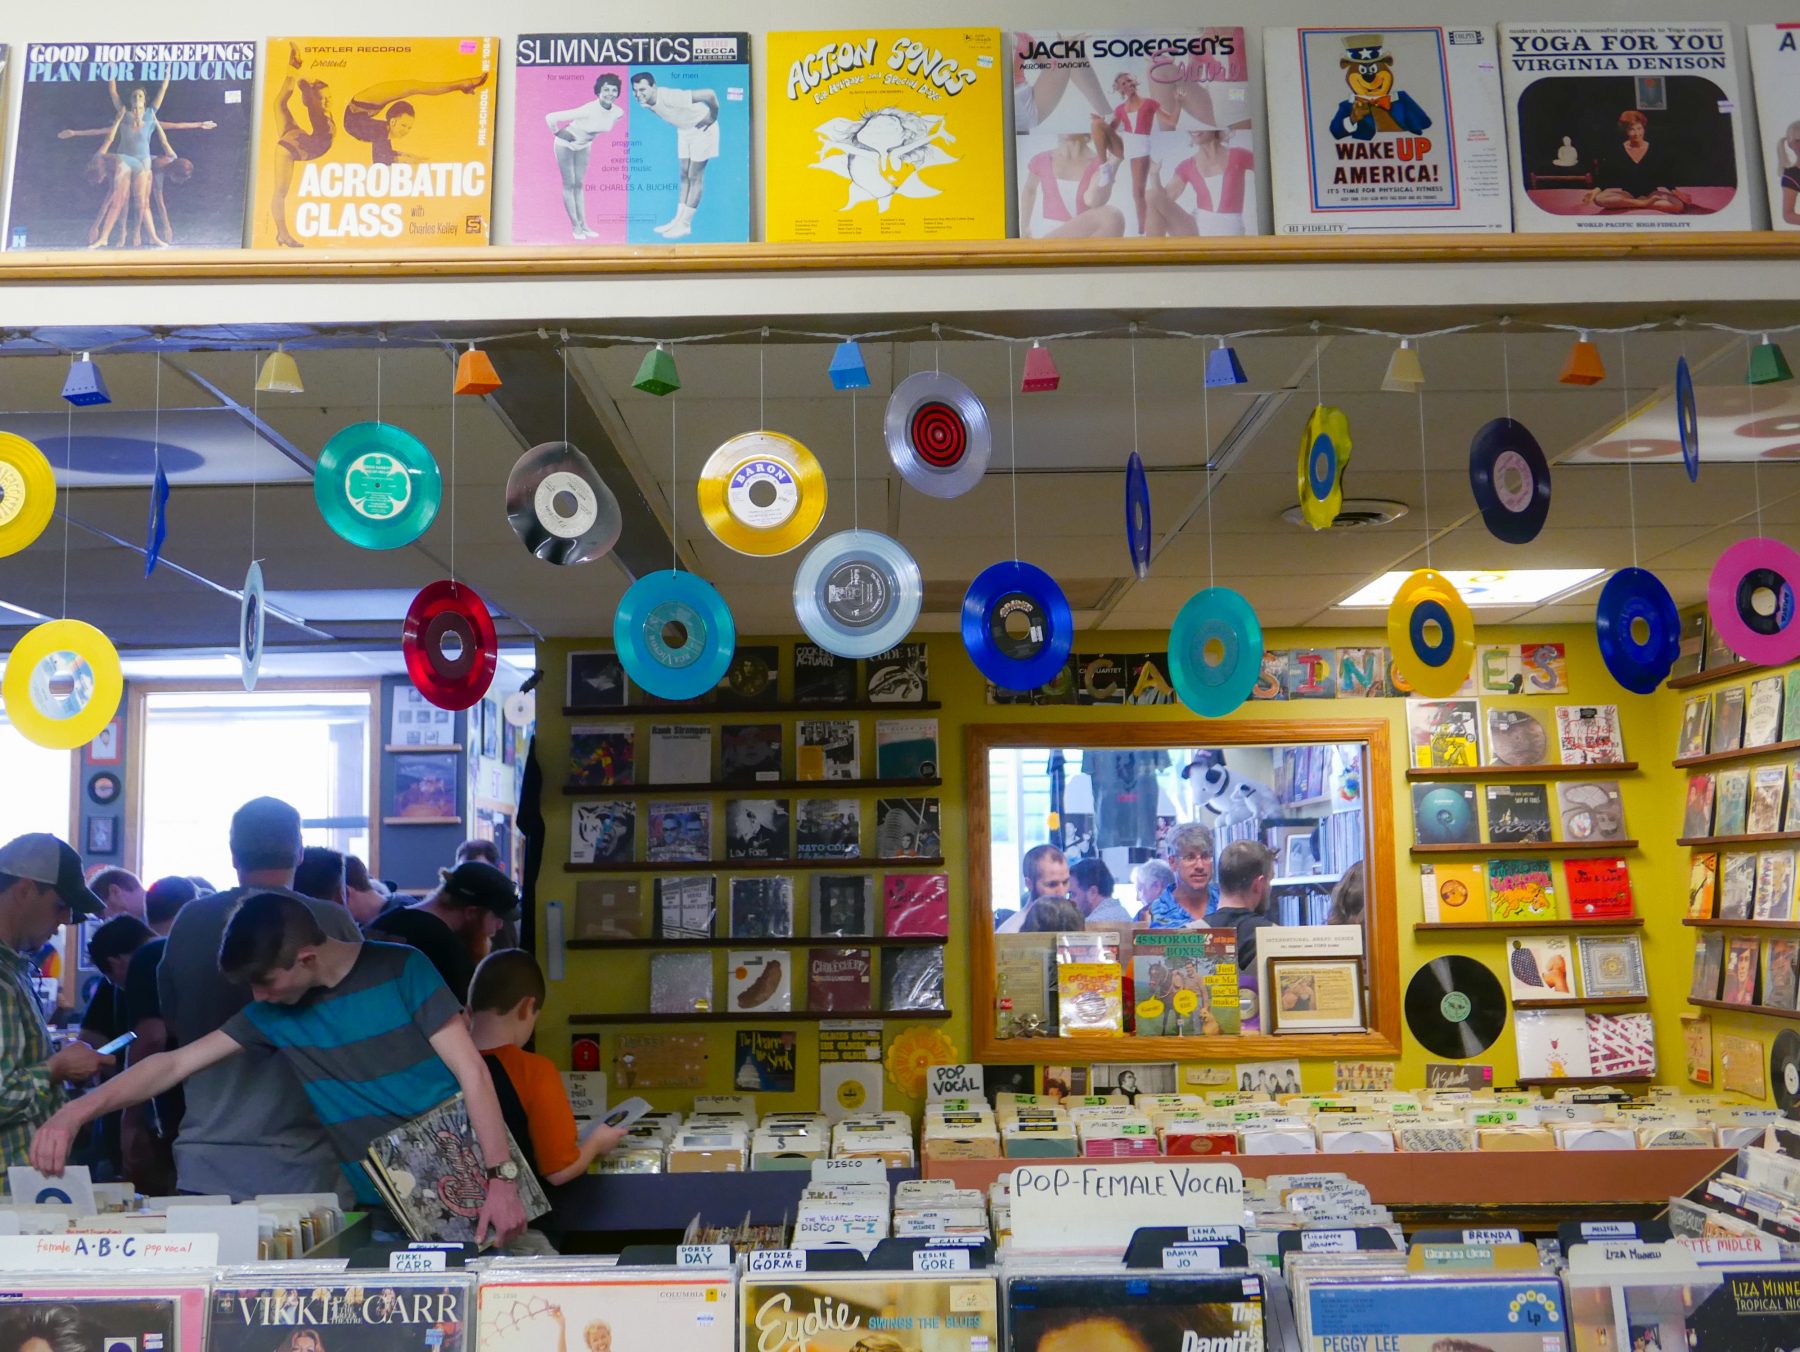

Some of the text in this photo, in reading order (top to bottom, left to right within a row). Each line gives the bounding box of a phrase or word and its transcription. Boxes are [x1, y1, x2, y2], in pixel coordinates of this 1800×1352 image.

[1019, 37, 1234, 60] JACKI SORENSEN'S
[1510, 35, 1724, 51] YOGA FOR YOU
[30, 43, 254, 63] GOOD HOUSEKEEPING'S
[518, 38, 691, 64] SLIMNASTICS
[1512, 57, 1726, 71] VIRGINIA DENISON
[28, 61, 253, 82] PLAN FOR REDUCING
[478, 89, 489, 146] PRE-SCHOOL
[612, 140, 642, 148] program
[1334, 137, 1432, 161] WAKE UP
[298, 162, 485, 197] ACROBATIC
[1333, 165, 1438, 185] AMERICA!
[600, 184, 634, 192] CHARLES
[411, 205, 425, 217] with
[296, 202, 403, 237] CLASS
[409, 223, 435, 234] Charles
[1302, 224, 1344, 232] FIDELITY
[735, 463, 786, 484] BARON
[1151, 934, 1203, 944] STORAGE
[1166, 947, 1203, 957] BOXES
[1217, 965, 1234, 973] Just
[937, 1065, 965, 1080] POP
[933, 1078, 980, 1095] VOCAL
[1566, 1108, 1576, 1119] S
[600, 1160, 643, 1169] PHILIPS
[827, 1160, 863, 1169] DISCO
[1016, 1167, 1242, 1199] POP-FEMALE VOCAL
[801, 1223, 835, 1232] DISCO
[1469, 1231, 1512, 1240] BRENDA
[36, 1238, 70, 1254] female
[144, 1243, 161, 1256] pop
[164, 1242, 192, 1252] vocal
[1717, 1238, 1762, 1252] MIDLER
[396, 1260, 432, 1271] CARR
[685, 1253, 713, 1264] DAY
[753, 1259, 803, 1271] GORME
[921, 1260, 956, 1271] GORE
[1177, 1259, 1191, 1268] JO
[1732, 1280, 1759, 1297] LIZA
[239, 1294, 461, 1326] VIKKI CARR
[1735, 1297, 1784, 1311] TROPICAL
[1232, 1303, 1262, 1321] This
[754, 1292, 860, 1352] Eydie
[868, 1316, 981, 1329] SWINGS THE BLUES
[1181, 1330, 1264, 1352] Damita
[1323, 1336, 1399, 1352] PEGGY LEE
